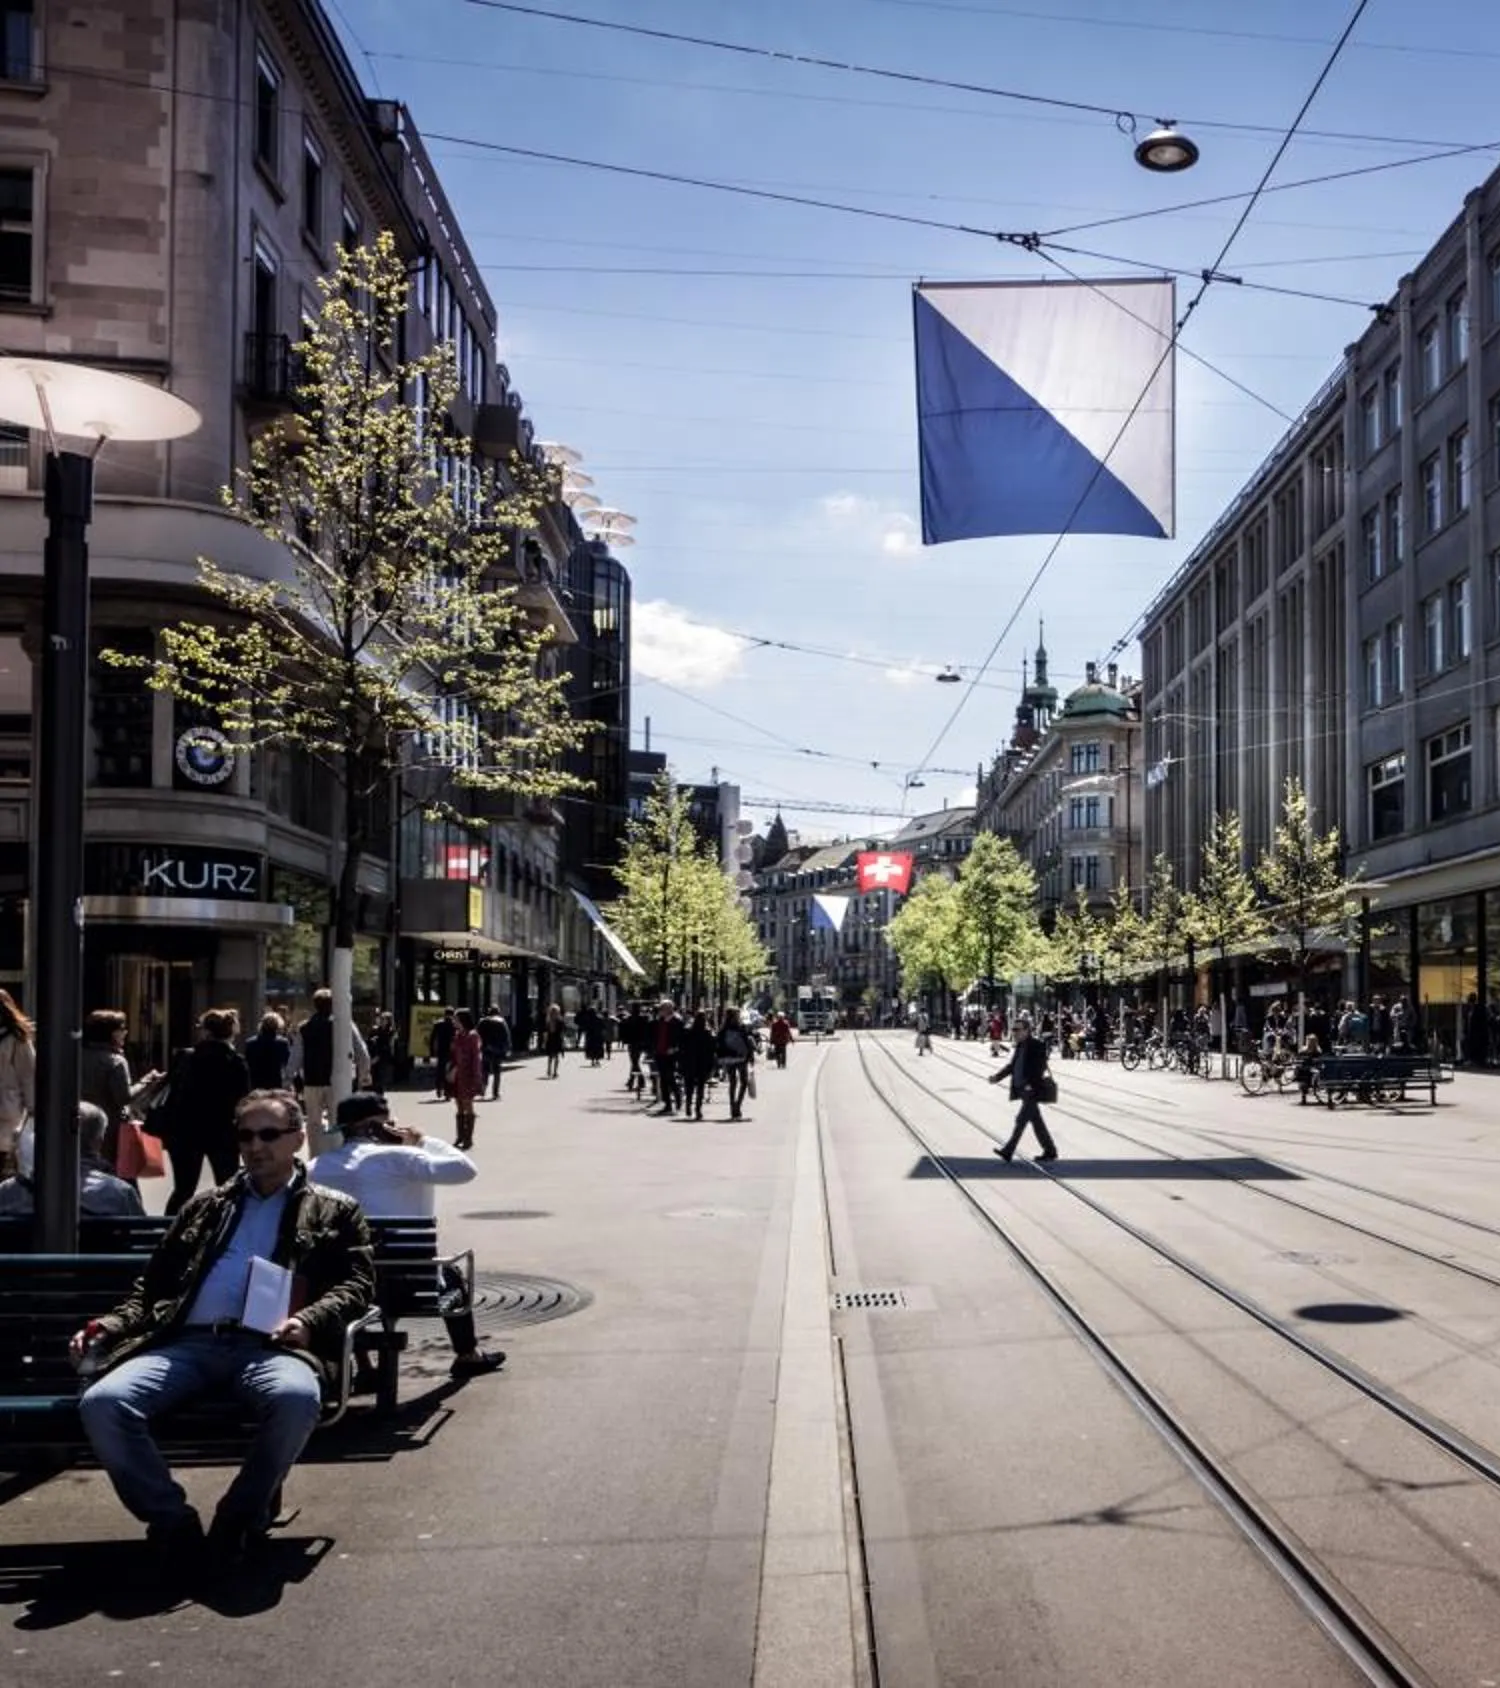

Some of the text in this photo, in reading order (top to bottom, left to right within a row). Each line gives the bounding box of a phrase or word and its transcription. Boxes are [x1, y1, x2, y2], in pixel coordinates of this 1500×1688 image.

[143, 859, 256, 893] KURZ
[434, 950, 470, 961] CHRIST
[481, 959, 512, 970] CHRIST
